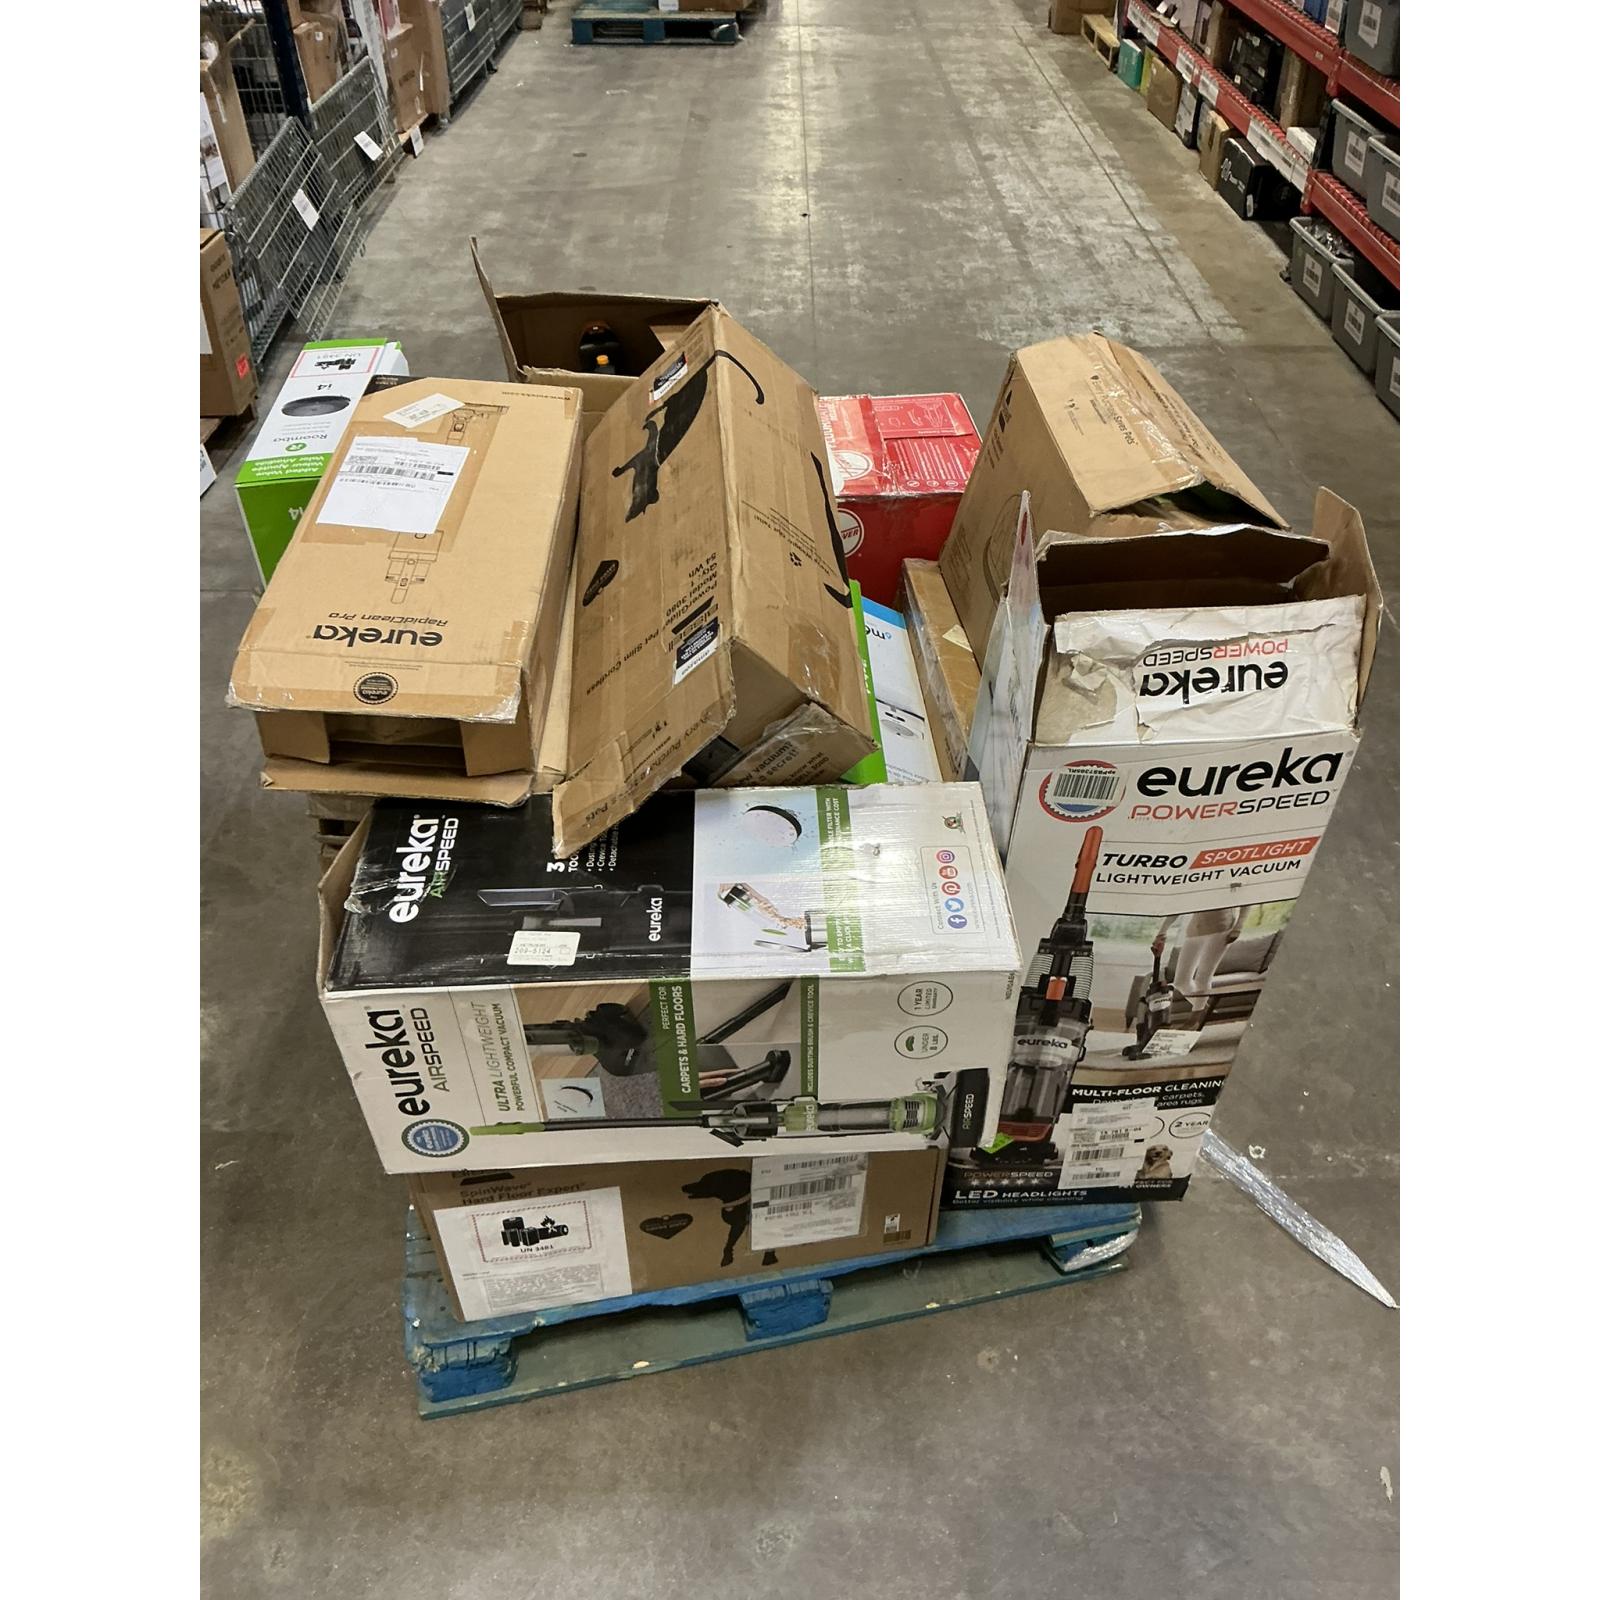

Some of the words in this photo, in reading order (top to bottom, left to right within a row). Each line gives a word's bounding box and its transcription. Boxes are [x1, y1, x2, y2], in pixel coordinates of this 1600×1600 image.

[316, 383, 333, 391] i4
[273, 433, 329, 443] Roomba
[285, 467, 319, 475] Added
[688, 563, 704, 578] Wh
[706, 552, 717, 564] 54
[689, 570, 718, 596] Model
[328, 612, 357, 621] Pro
[664, 580, 718, 628] PowerGlide
[360, 613, 448, 627] RapidClean
[312, 624, 443, 648] eureka
[645, 628, 659, 645] Pet
[624, 642, 643, 661] Slim
[1142, 638, 1288, 668] POWERSPEED
[586, 660, 622, 696] Cordless
[1138, 661, 1288, 704] eureka
[1136, 747, 1345, 797] eureka
[1130, 790, 1332, 821] POWERSPEED
[428, 817, 460, 898] AIRSPEED
[1102, 853, 1189, 869] TURBO
[1199, 839, 1312, 866] SPOTLIGHT
[388, 816, 440, 924] eureka
[547, 862, 565, 872] 3
[1095, 868, 1225, 886] LIGHTWEIGHT
[1228, 859, 1302, 878] VACUUM
[646, 896, 663, 942] eureka
[659, 987, 667, 1000] FOR
[672, 986, 684, 1020] FLOORS
[914, 989, 922, 1005] YEAR
[924, 988, 932, 1009] LIMITED
[491, 1003, 505, 1034] VACUUM
[661, 1003, 669, 1030] PERFECT
[471, 1002, 503, 1079] LIGHTWEIGHT
[676, 1021, 687, 1046] HARD
[921, 1033, 929, 1052] UNDER
[1017, 1037, 1068, 1050] eureka
[410, 1007, 450, 1092] AIRSPEED
[500, 1035, 515, 1072] COMPACT
[678, 1046, 689, 1055] &
[365, 1009, 431, 1116] eureka
[679, 1055, 692, 1094] CARPETS
[492, 1080, 511, 1111] ULTRA
[509, 1073, 525, 1111] POWERFUL
[1071, 1085, 1162, 1099] MULTI-FLOOR
[459, 1184, 527, 1198] SpinWave
[498, 1190, 534, 1201] Floor
[536, 1184, 580, 1197] Expert
[954, 1190, 999, 1199] LED
[1002, 1189, 1088, 1198] HEADLIGHTS
